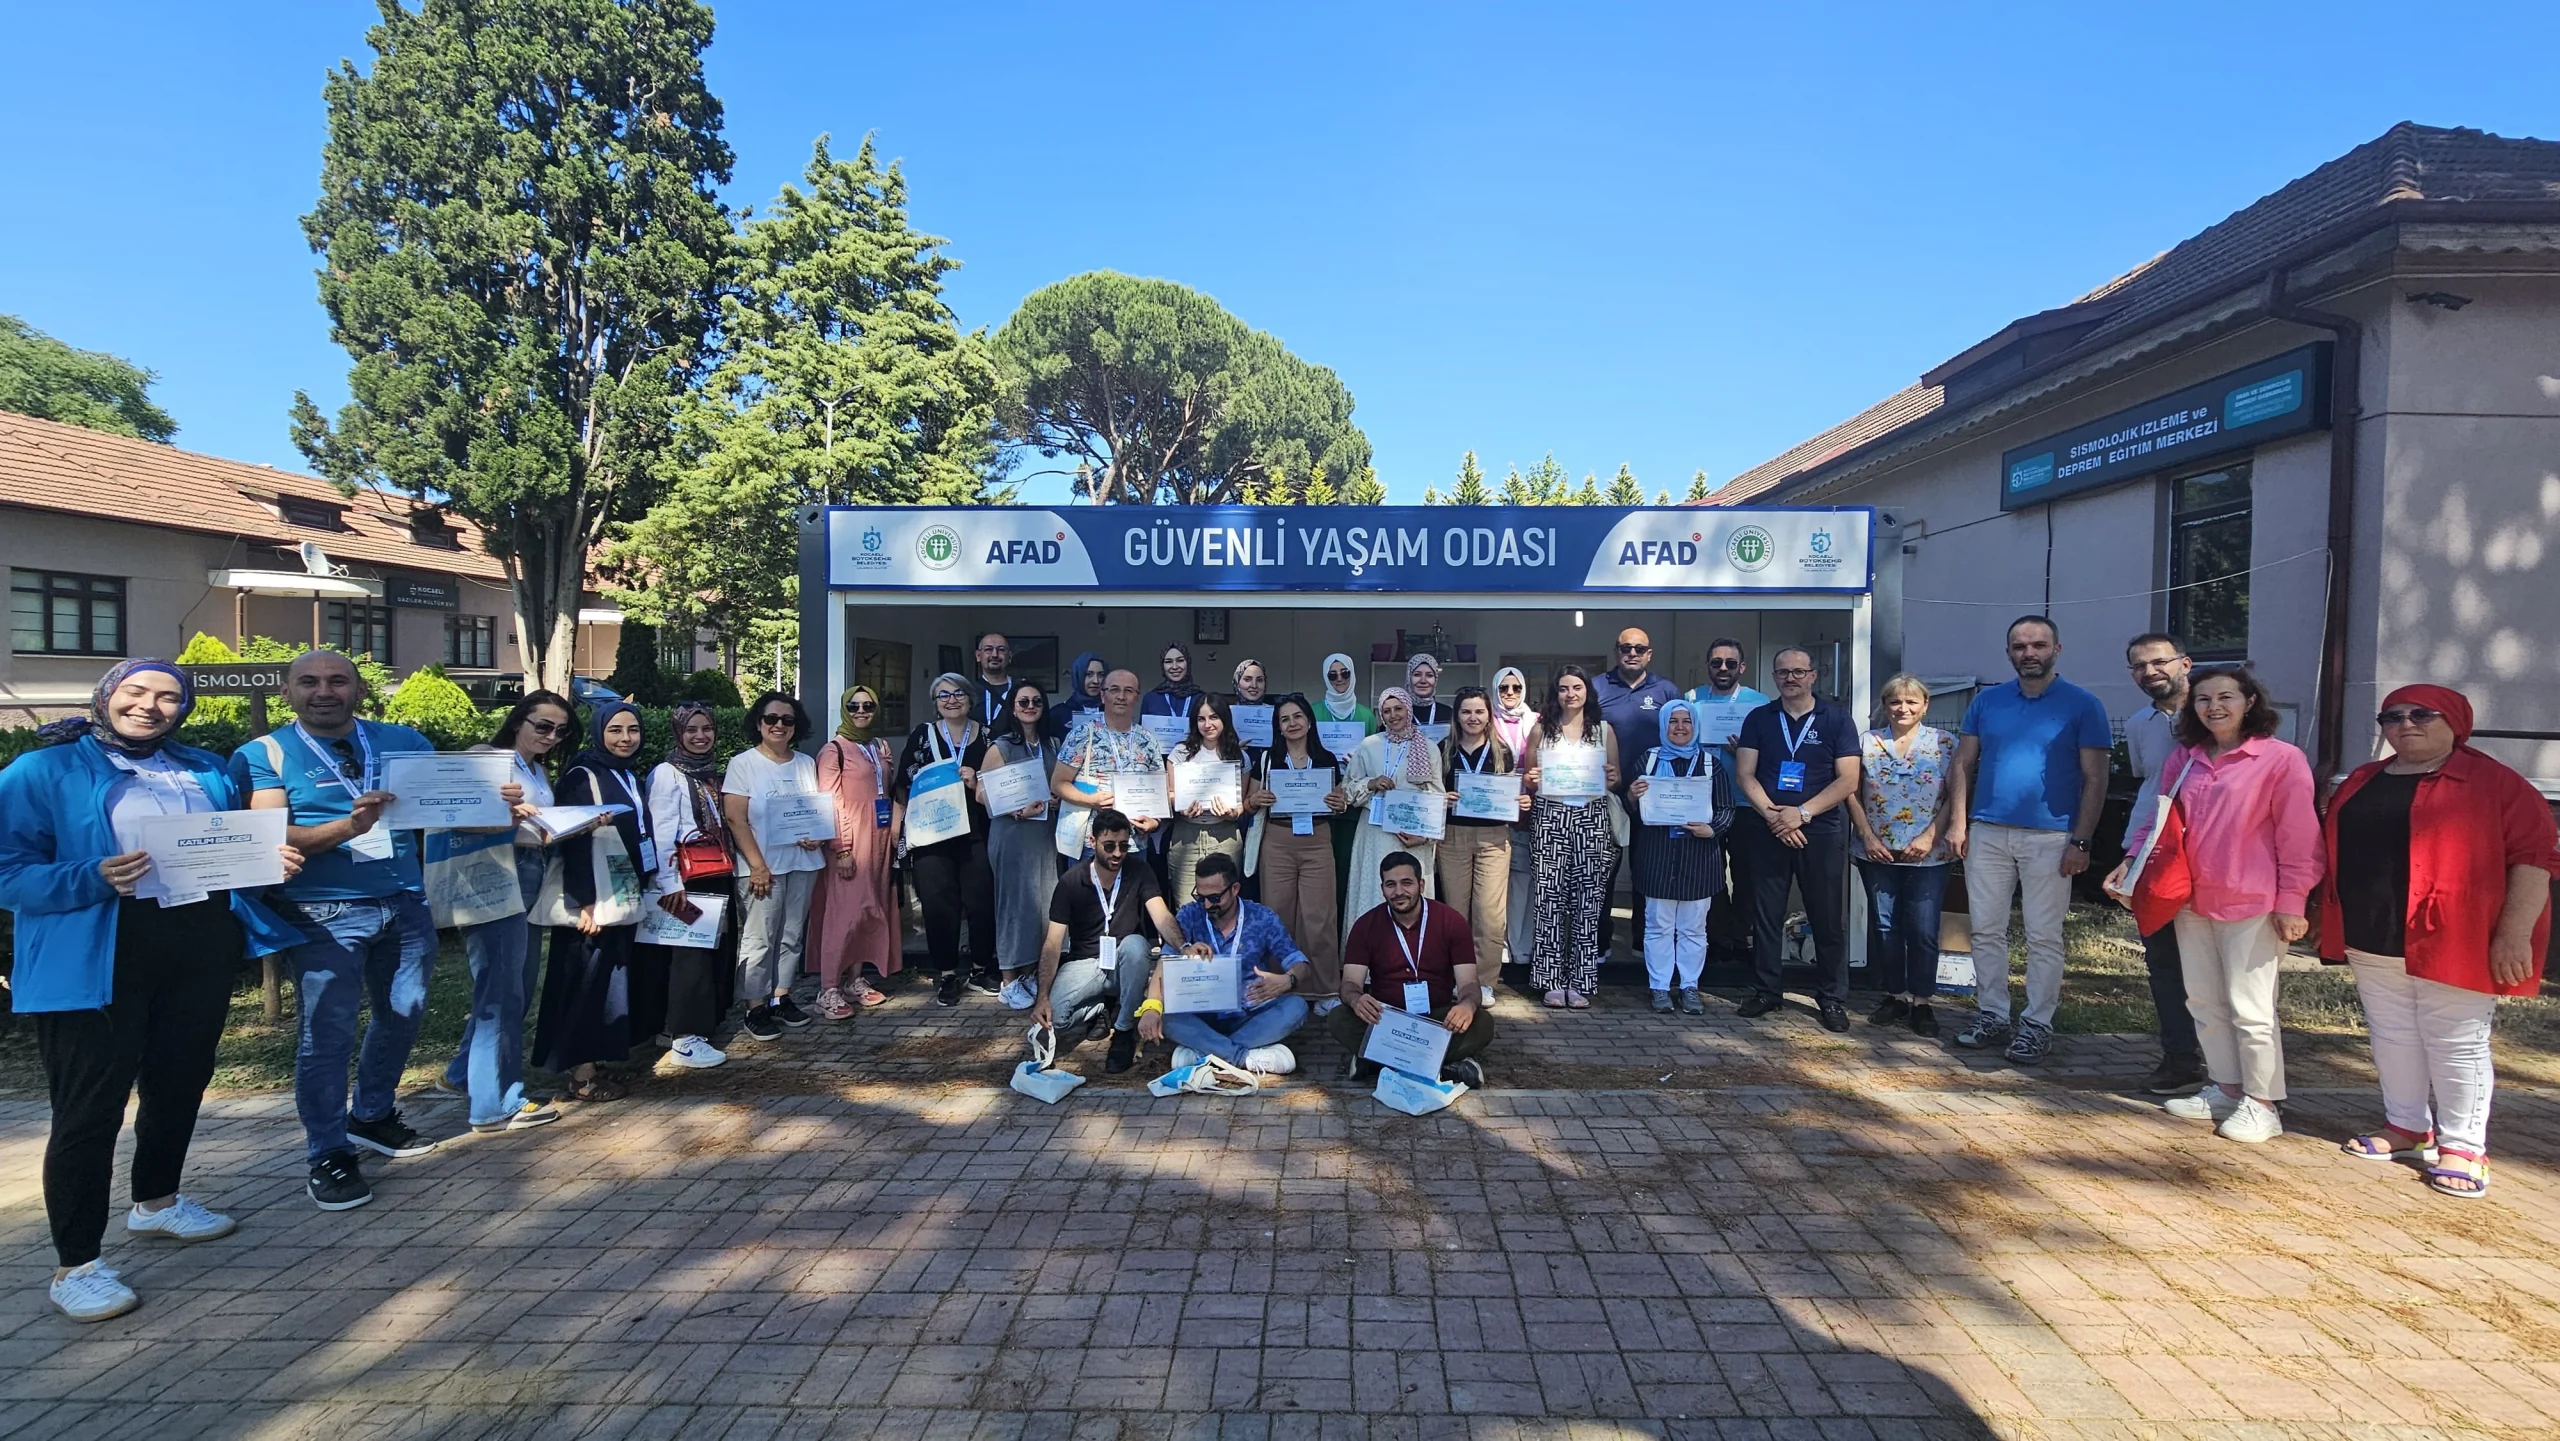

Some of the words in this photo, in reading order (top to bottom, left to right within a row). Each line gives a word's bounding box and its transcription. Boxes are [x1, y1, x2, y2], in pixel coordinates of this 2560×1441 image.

[2070, 427, 2139, 458] SİSMOLOJİK
[2141, 410, 2188, 436] İZLEME
[2192, 407, 2207, 420] ve
[2058, 456, 2101, 479] DEPREM
[2109, 440, 2152, 463] EĞİTİM
[2156, 417, 2218, 450] MERKEZİ
[985, 540, 1061, 564] AFAD
[1124, 518, 1285, 566] GÜVENLİ
[1298, 527, 1428, 576] YAŞAM
[1443, 527, 1556, 567] ODASI
[1618, 541, 1697, 565] AFAD
[193, 670, 281, 688] İSMOLOJİ
[179, 837, 215, 846] KATILIM
